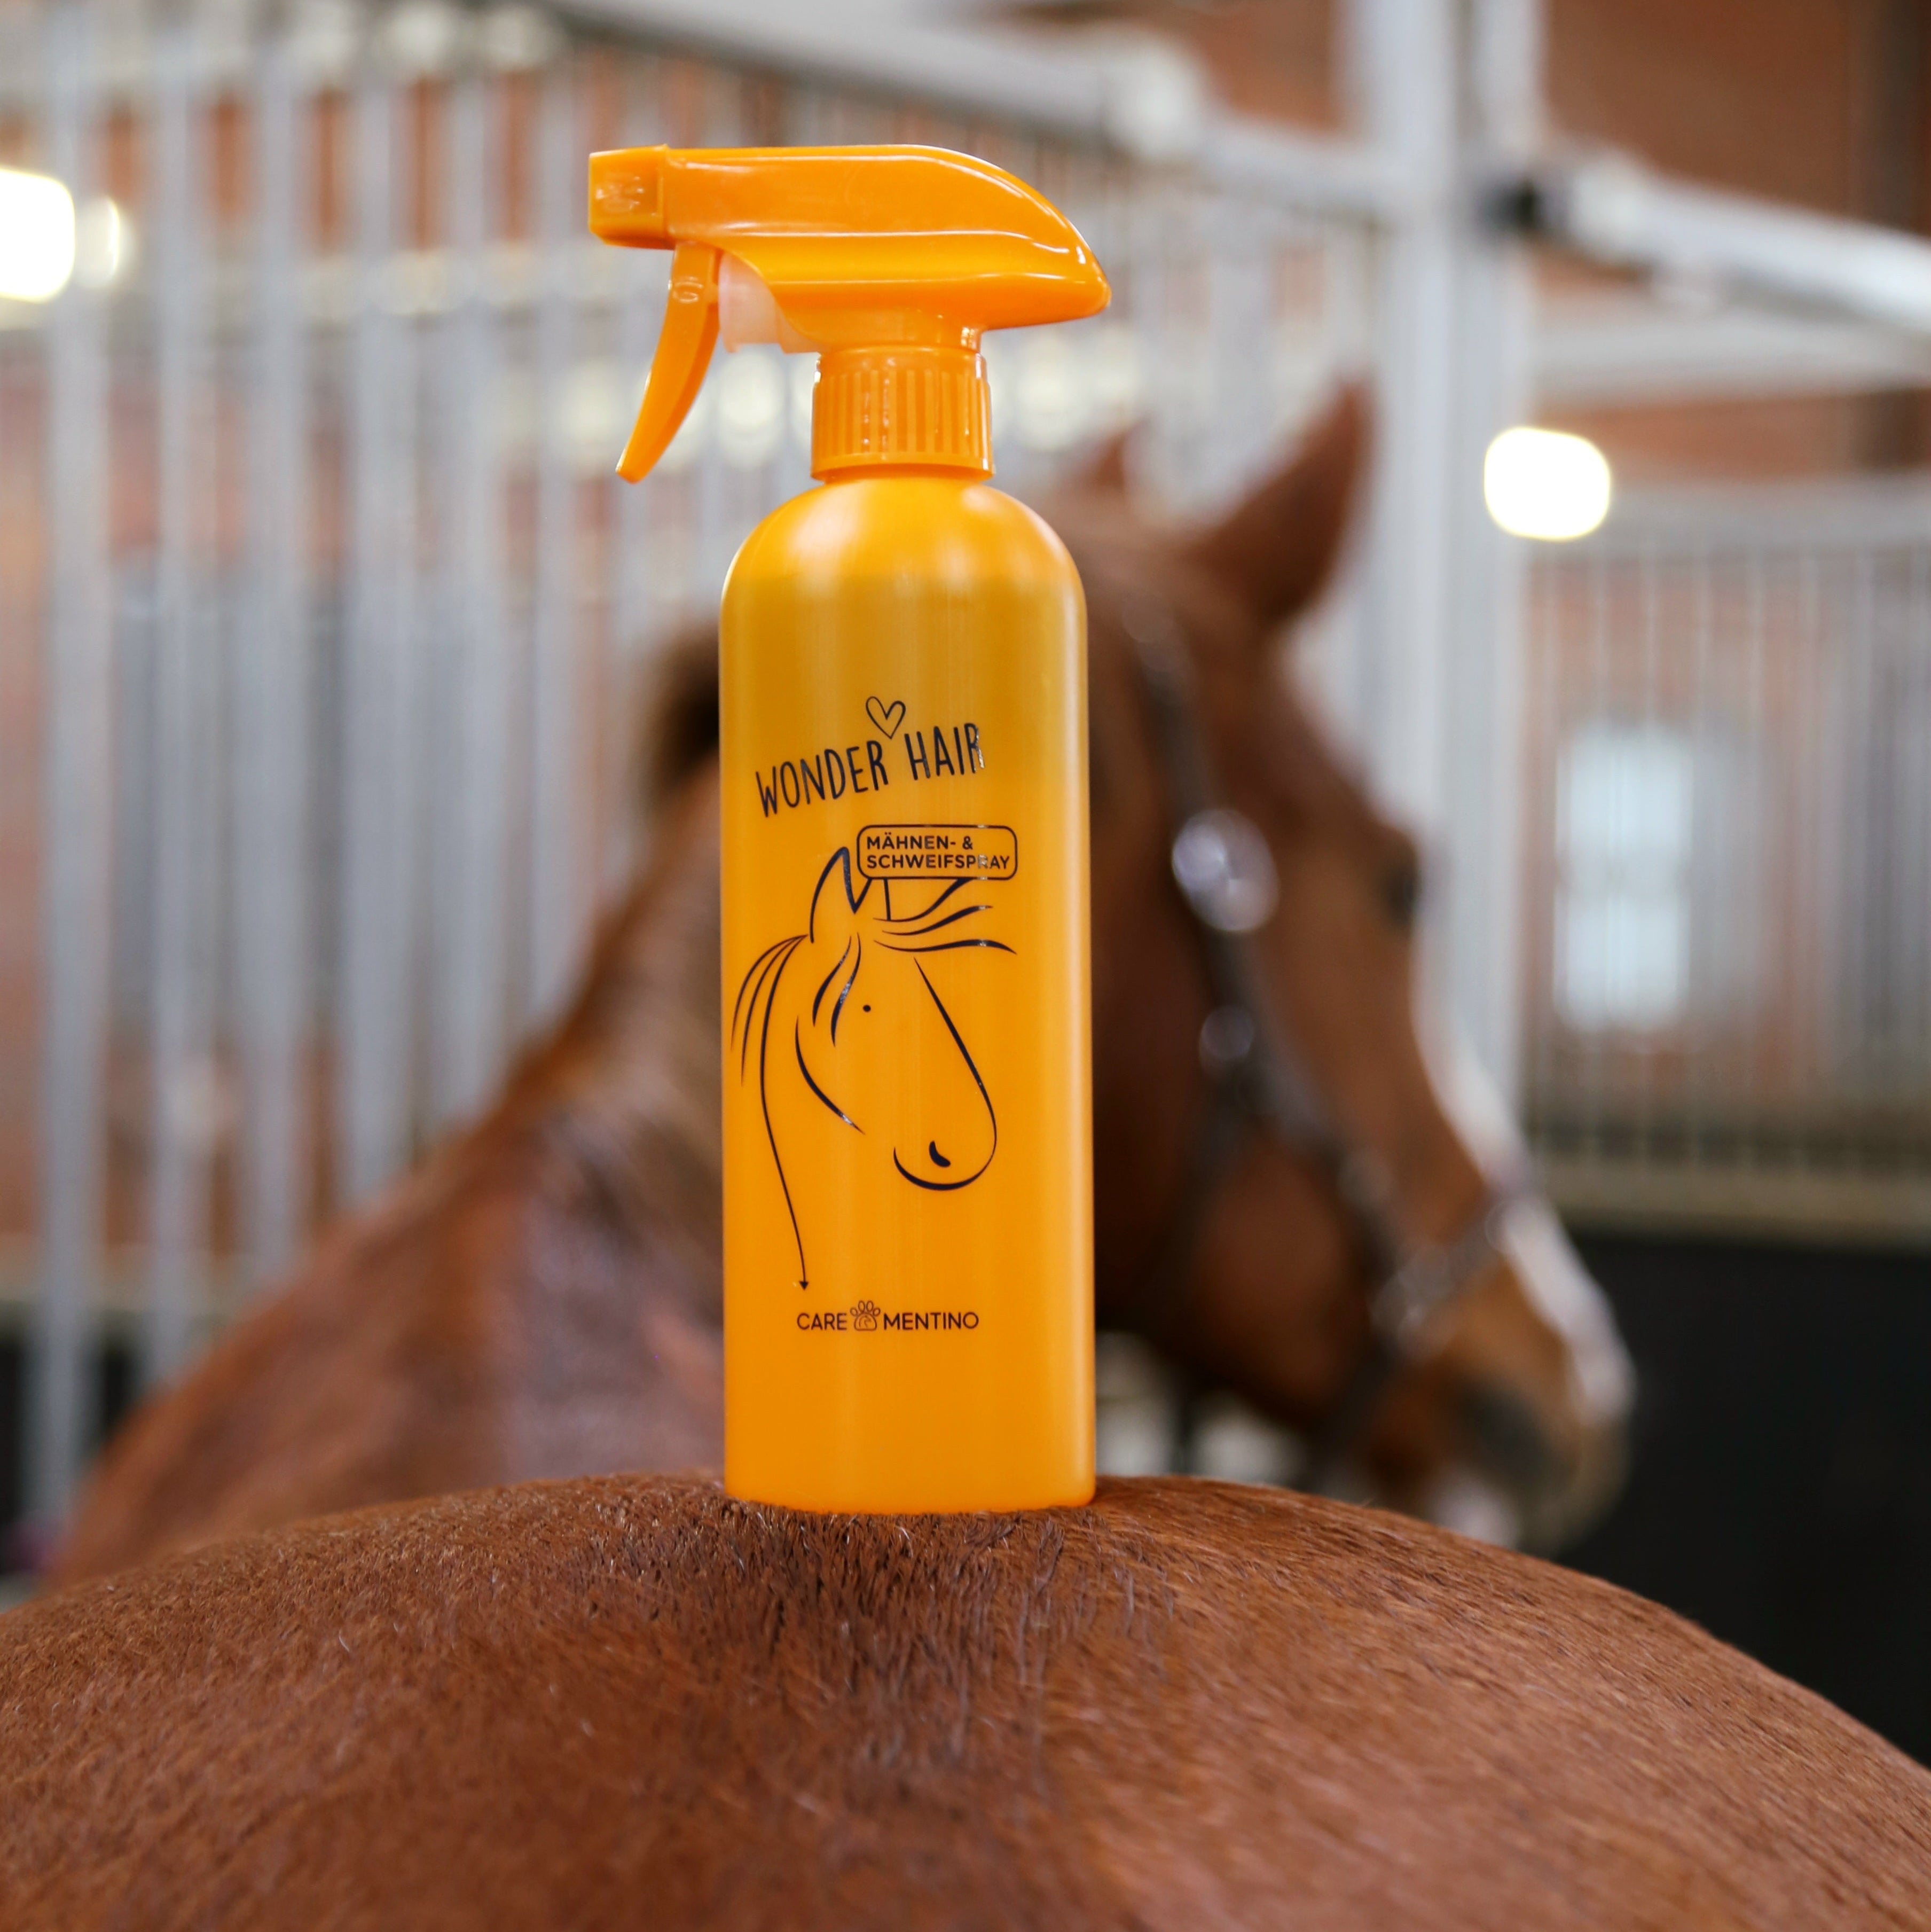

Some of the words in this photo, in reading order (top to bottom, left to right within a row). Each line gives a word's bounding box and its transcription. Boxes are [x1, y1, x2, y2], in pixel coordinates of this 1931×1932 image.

[756, 740, 889, 817] WONDER
[904, 723, 985, 780] HAIR
[866, 832, 956, 850] MÄHNEN-
[962, 836, 973, 850] &
[866, 854, 1010, 869] SCHWEIFSPRAY
[797, 1312, 847, 1330] CARE
[883, 1312, 979, 1330] MENTINO
